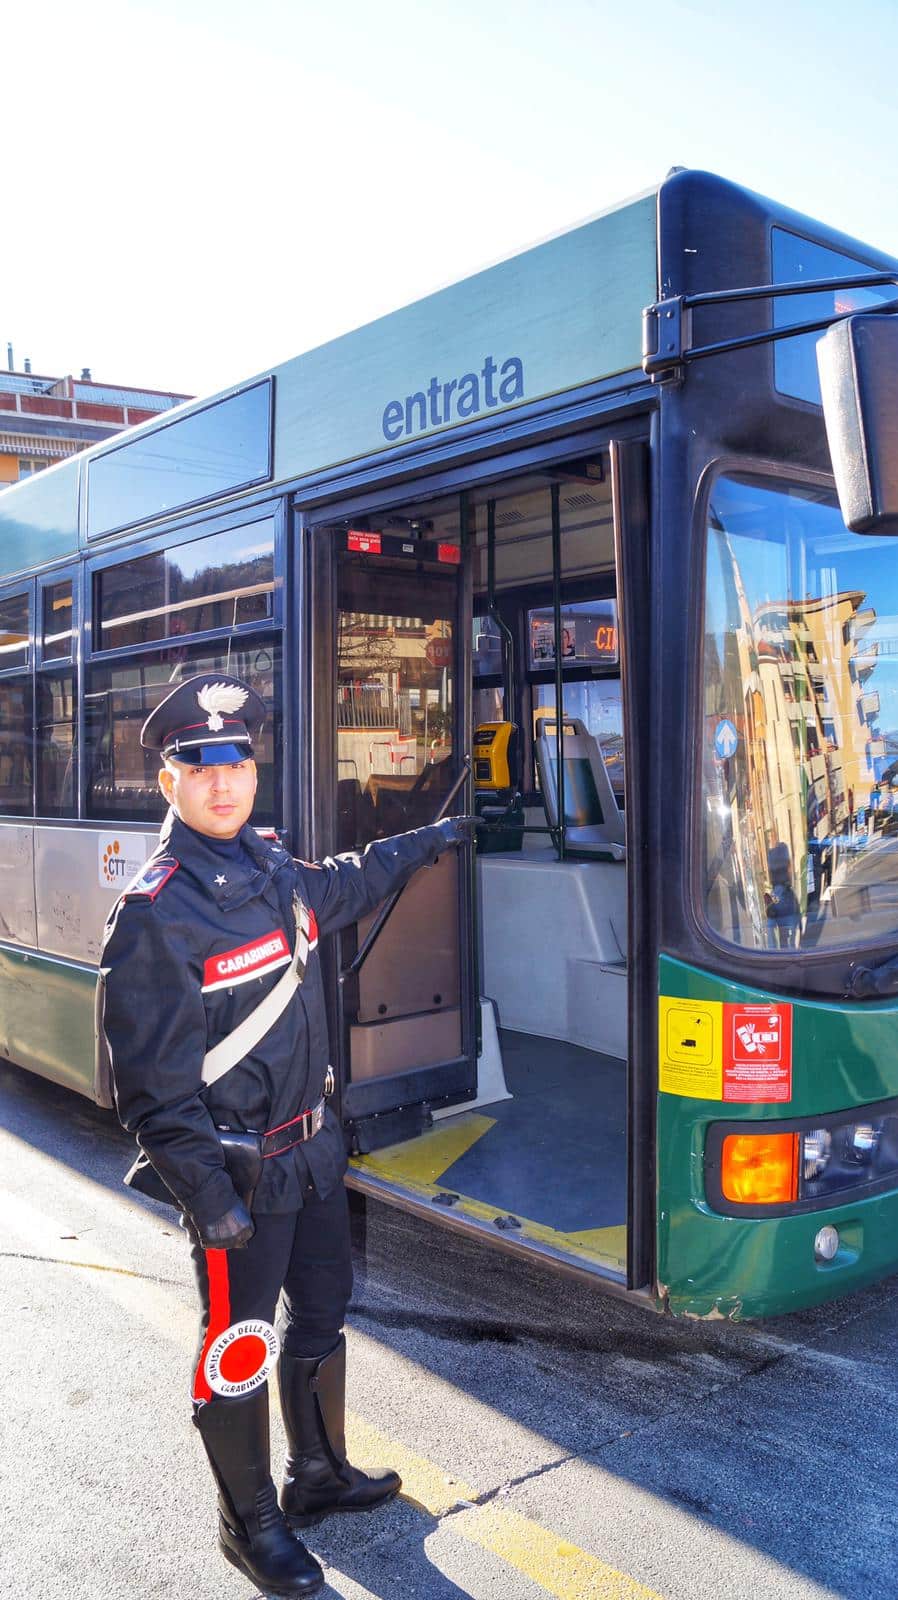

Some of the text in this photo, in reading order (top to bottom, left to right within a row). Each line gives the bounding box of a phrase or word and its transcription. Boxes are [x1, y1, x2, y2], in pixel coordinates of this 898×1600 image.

[382, 356, 524, 441] entrata
[108, 858, 126, 876] CTT
[217, 937, 284, 975] CARABINIERI
[208, 1324, 277, 1381] MINISTERO DELLA DIFESA
[220, 1366, 270, 1393] CARABINIERI
